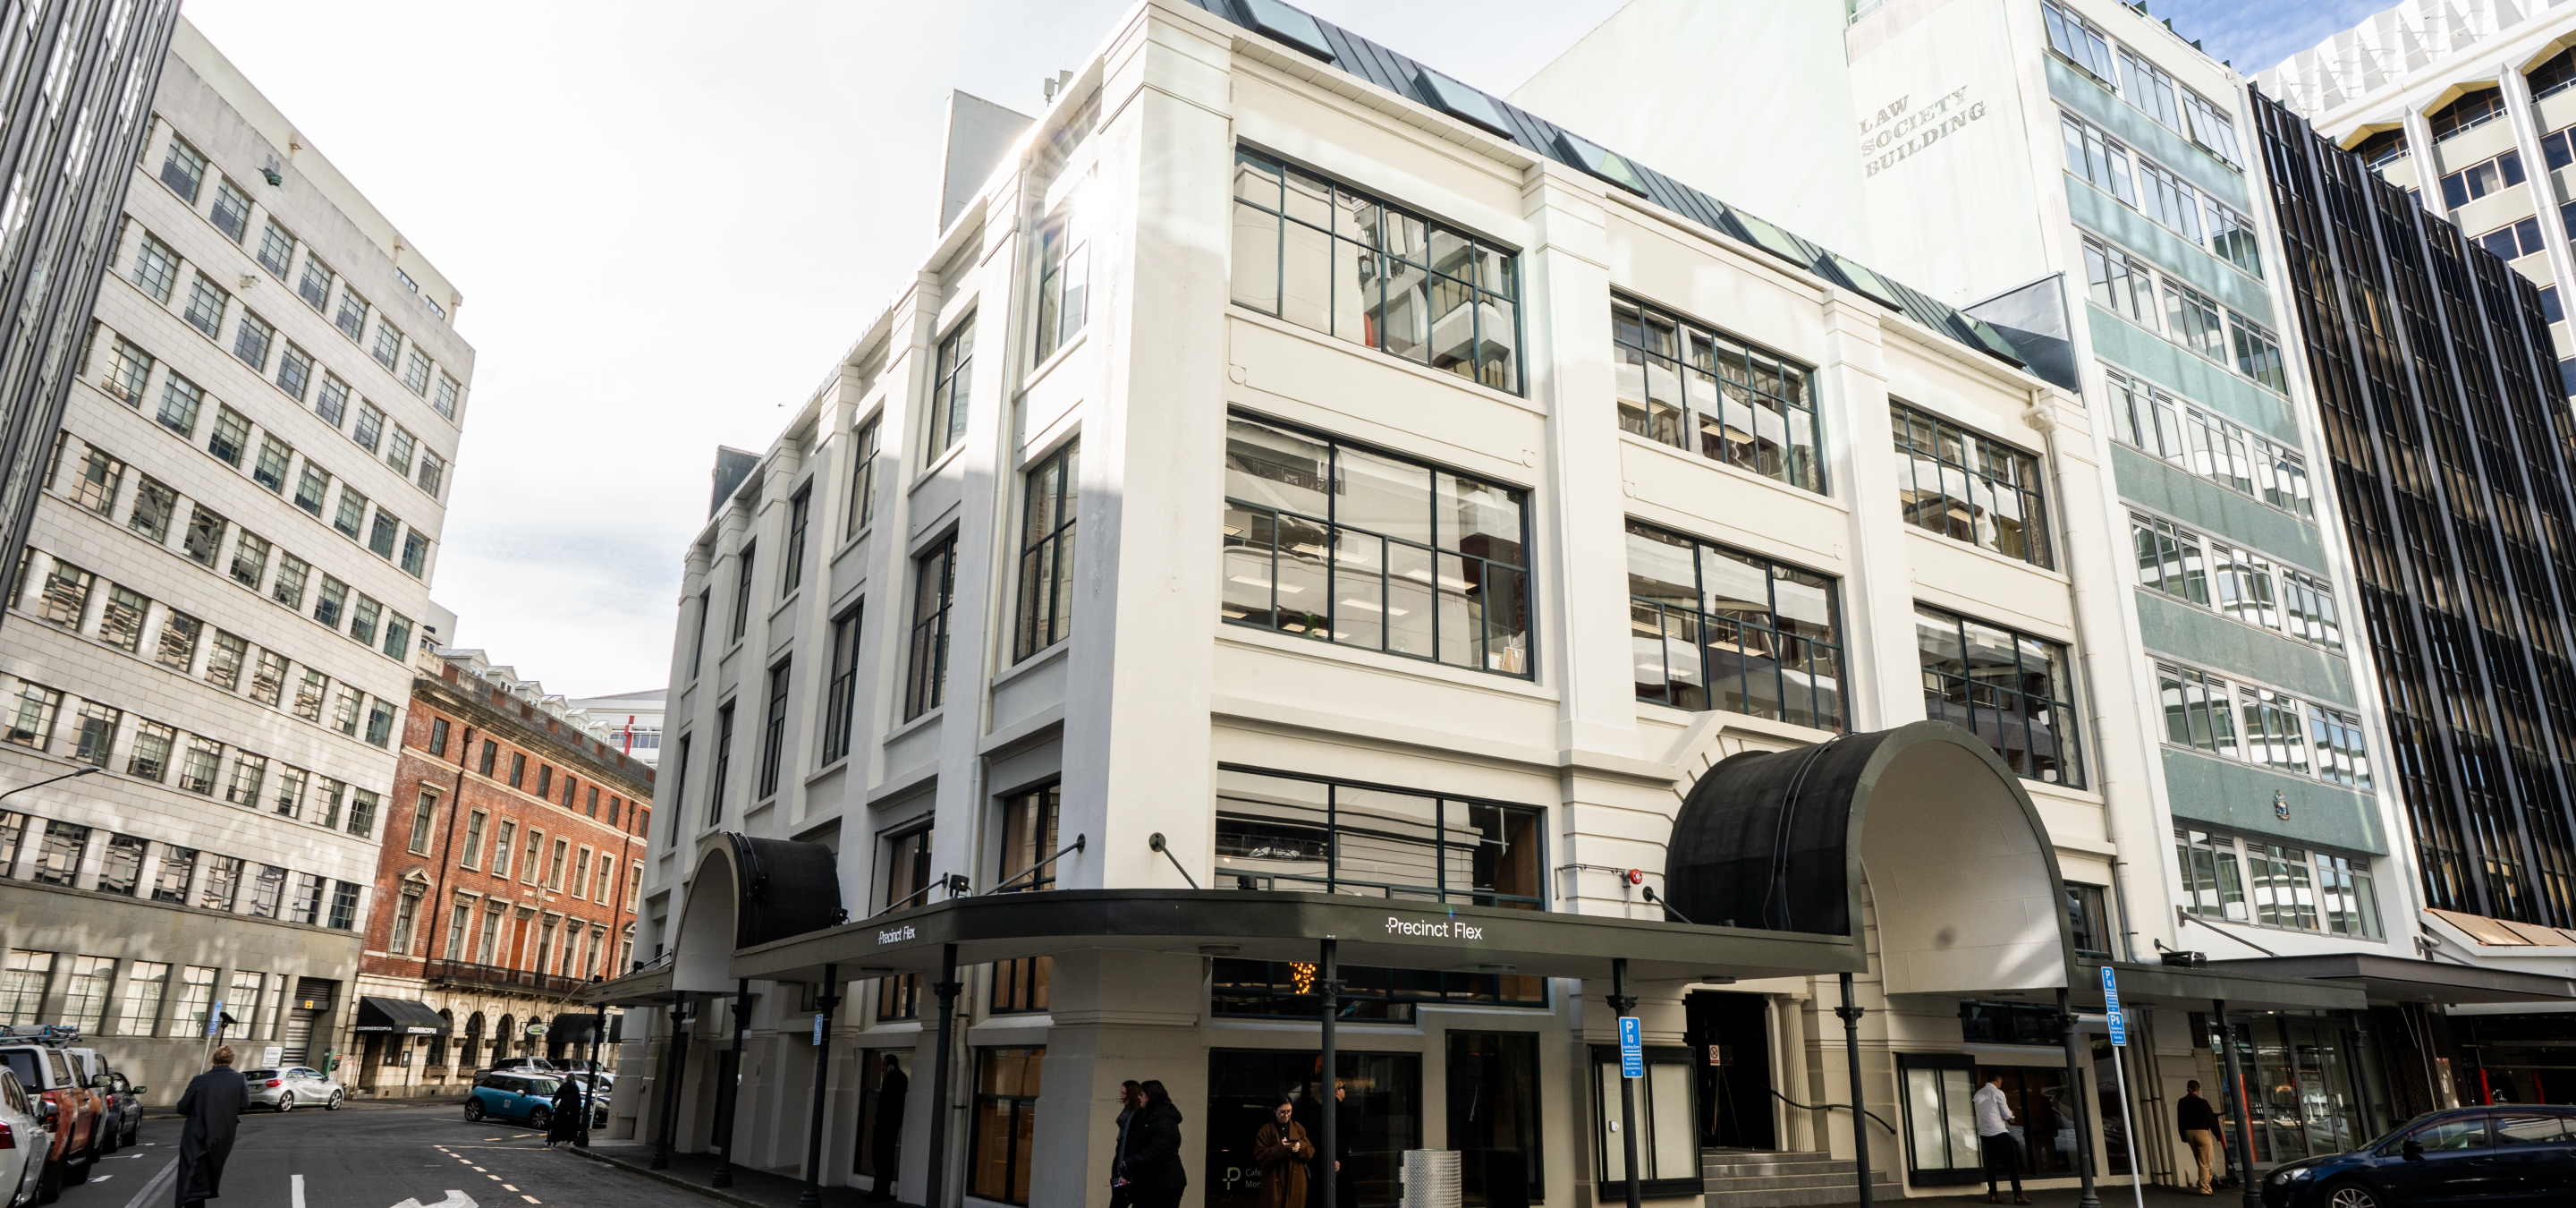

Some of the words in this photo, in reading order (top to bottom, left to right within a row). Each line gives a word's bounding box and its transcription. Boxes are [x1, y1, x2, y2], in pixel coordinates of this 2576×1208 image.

[1859, 94, 1909, 136] LAW
[1860, 84, 1968, 157] SOCIETY
[1865, 100, 1987, 179] BUILDING
[878, 928, 902, 945] Precinct
[902, 925, 916, 940] Flex
[1385, 917, 1449, 938] Precinct
[1454, 922, 1483, 940] Flex
[408, 1026, 437, 1034] CORNERCOPIA
[1626, 1021, 1633, 1034] P
[1627, 1034, 1633, 1043] 10
